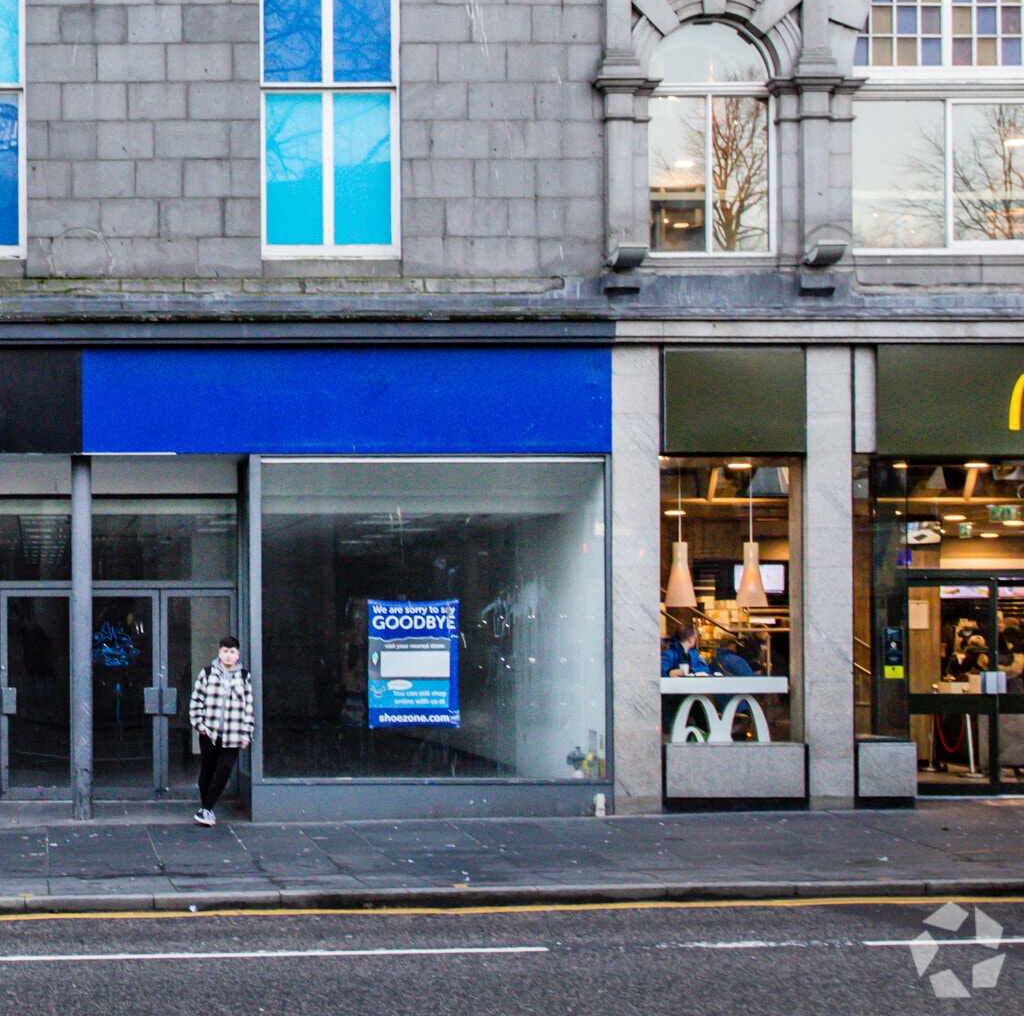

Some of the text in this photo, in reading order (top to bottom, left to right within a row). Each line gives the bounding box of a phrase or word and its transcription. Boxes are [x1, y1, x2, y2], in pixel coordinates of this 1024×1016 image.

[372, 605, 387, 614] We
[389, 606, 403, 614] are
[405, 605, 428, 616] sorry
[429, 606, 439, 614] to
[372, 615, 456, 630] GOODBYE
[378, 713, 450, 723] shoezone.com
